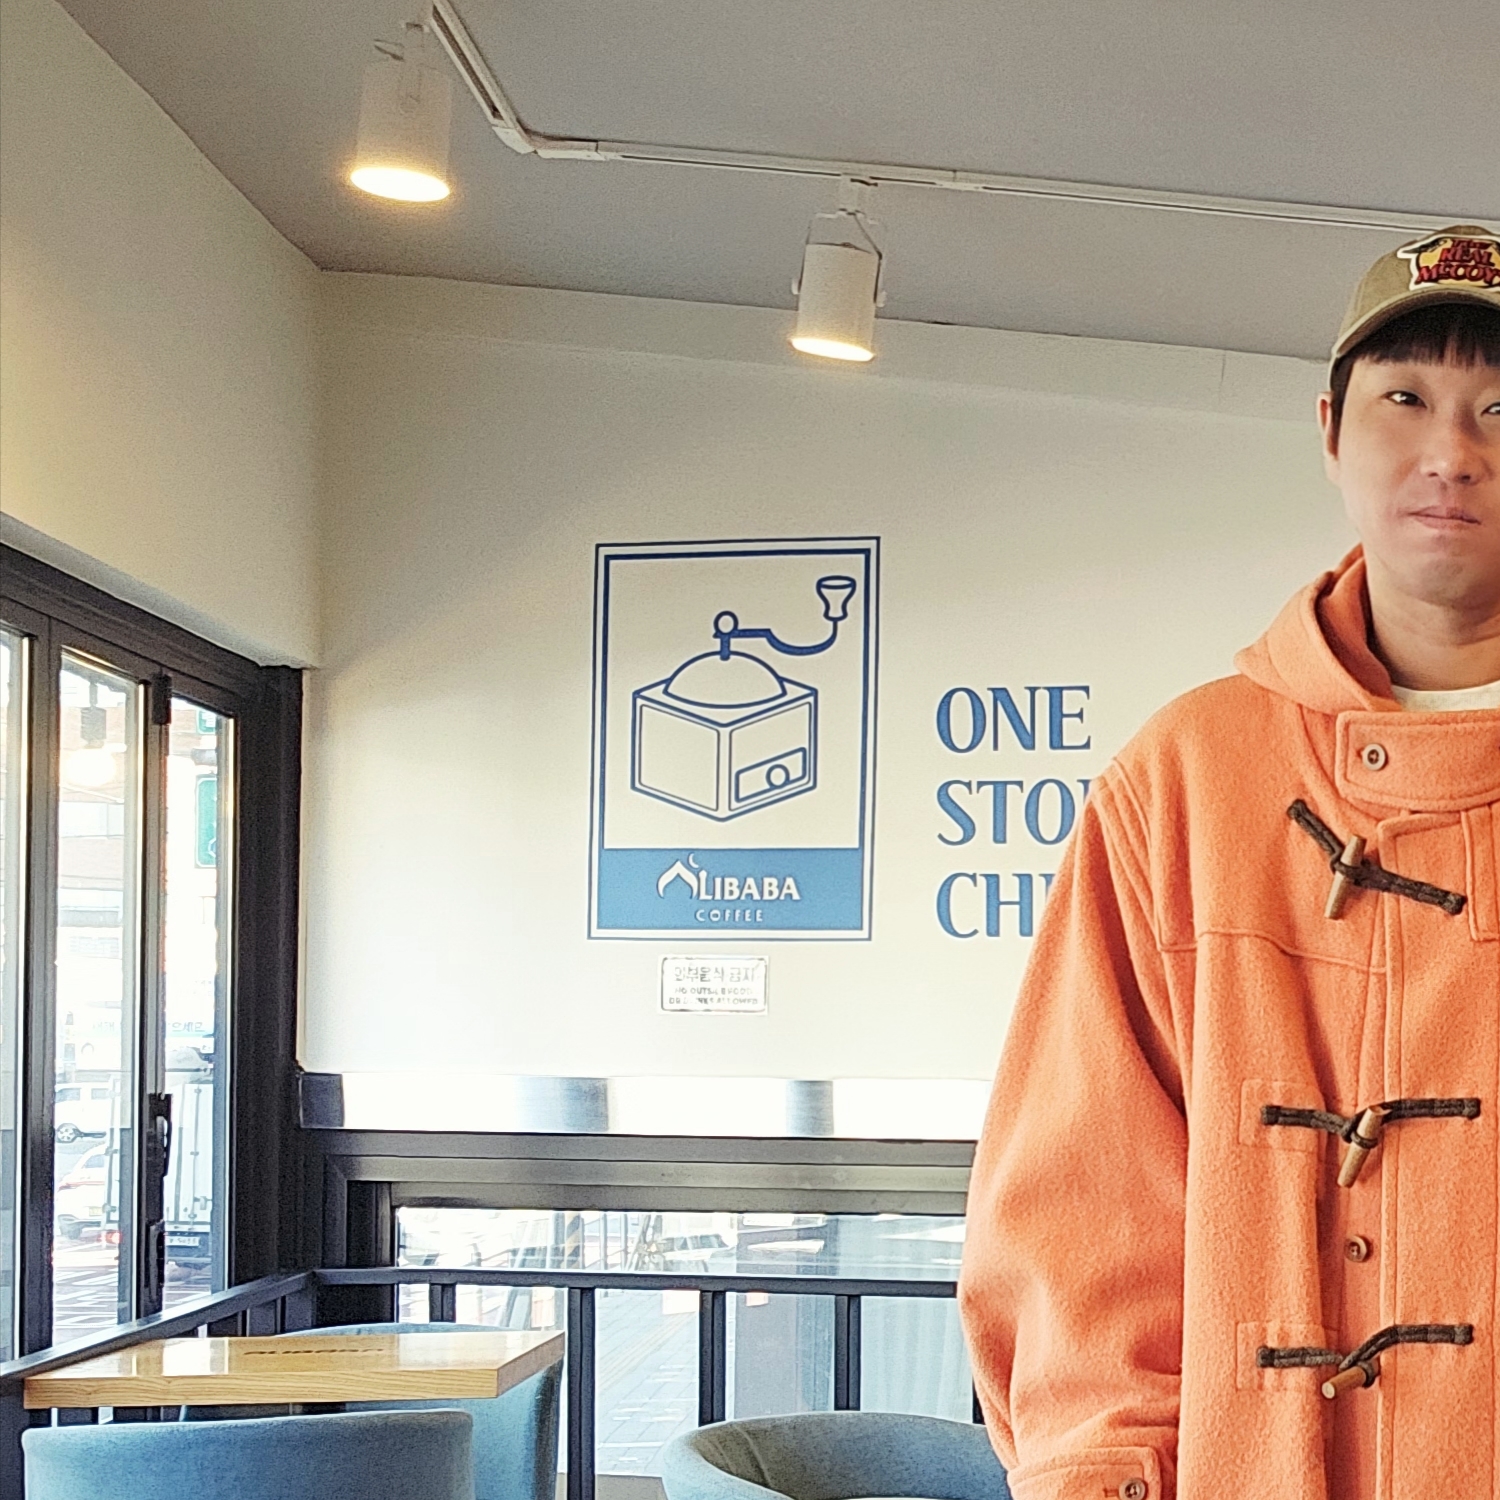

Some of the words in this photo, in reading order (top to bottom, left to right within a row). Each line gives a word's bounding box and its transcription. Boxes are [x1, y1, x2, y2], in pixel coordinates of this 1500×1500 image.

[1438, 247, 1495, 267] REAL
[936, 685, 1091, 753] ONE
[695, 909, 763, 922] COFFEE
[936, 872, 1057, 938] CH
